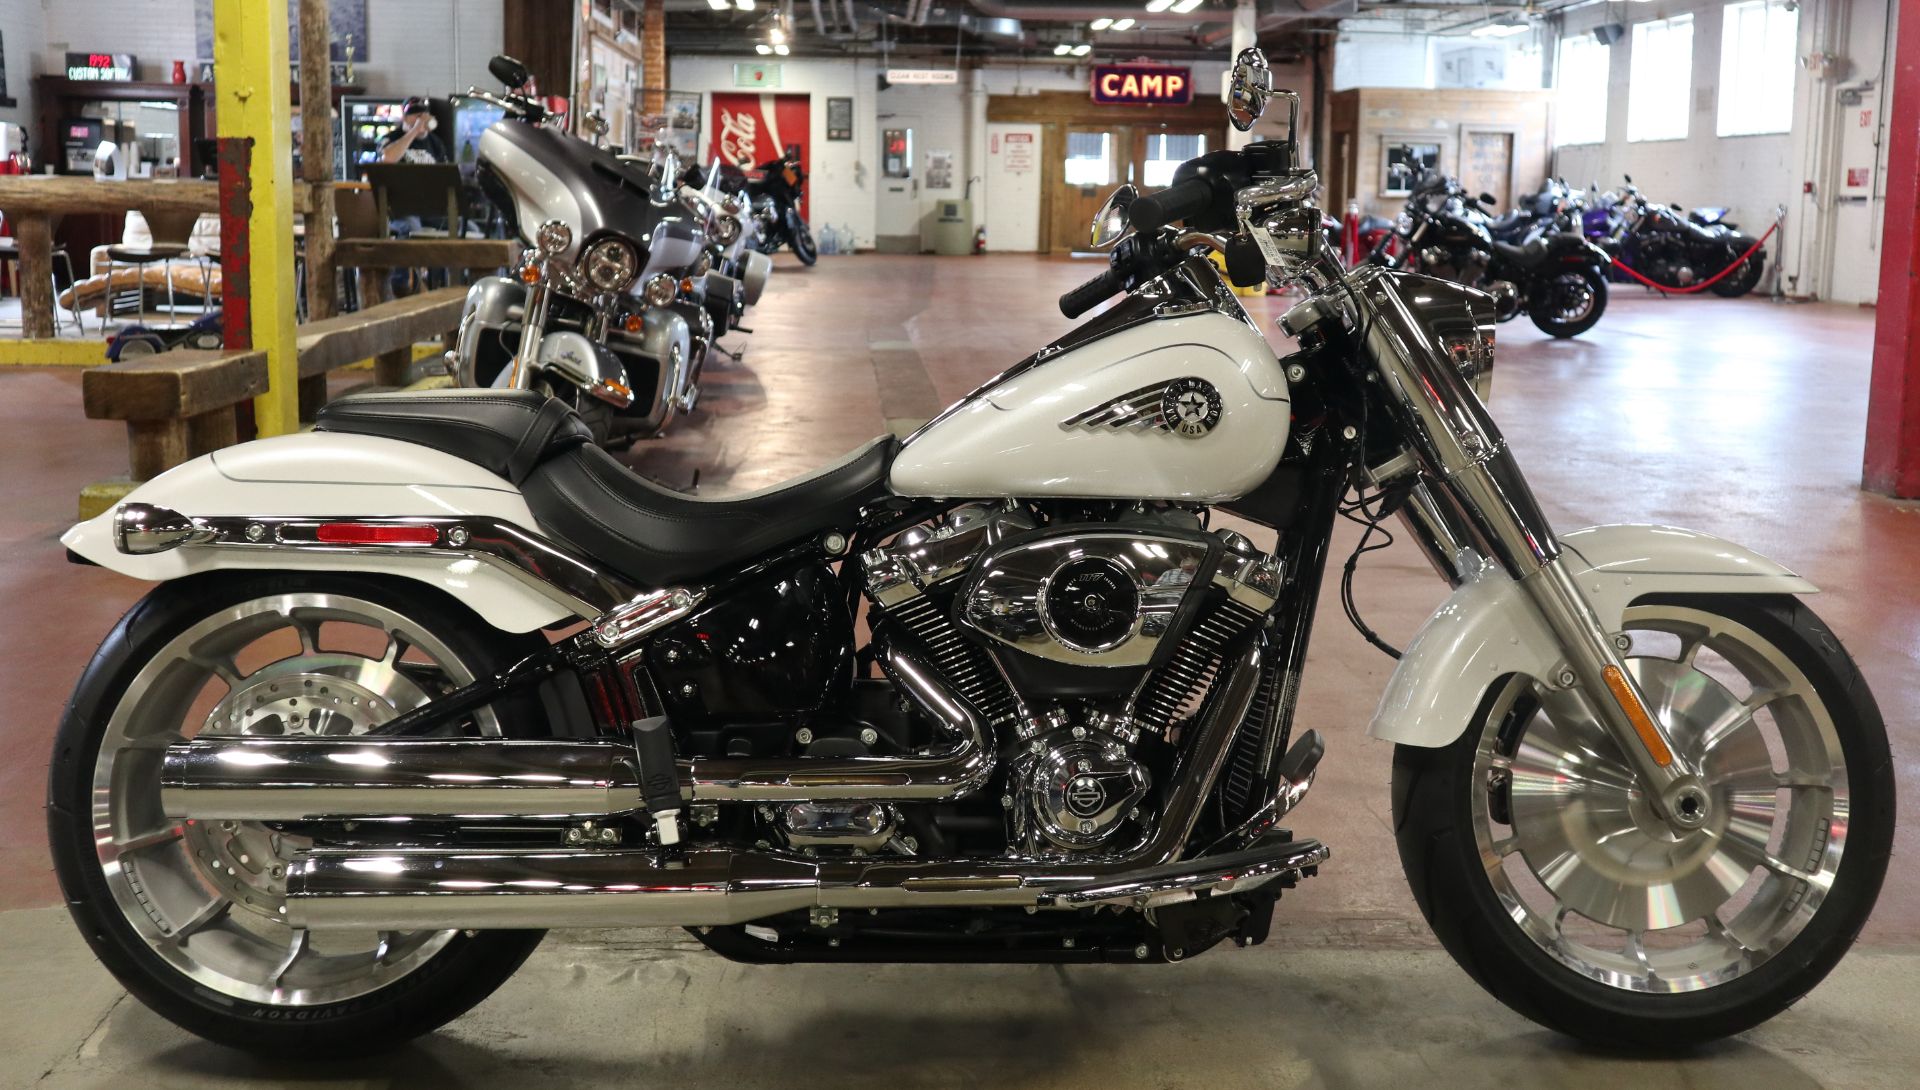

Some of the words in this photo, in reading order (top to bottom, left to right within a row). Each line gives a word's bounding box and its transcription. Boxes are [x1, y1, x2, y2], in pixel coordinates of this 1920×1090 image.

[69, 67, 99, 80] CUSTOM
[1101, 73, 1184, 97] CAMP
[720, 106, 756, 172] Cola
[1181, 423, 1203, 435] USA
